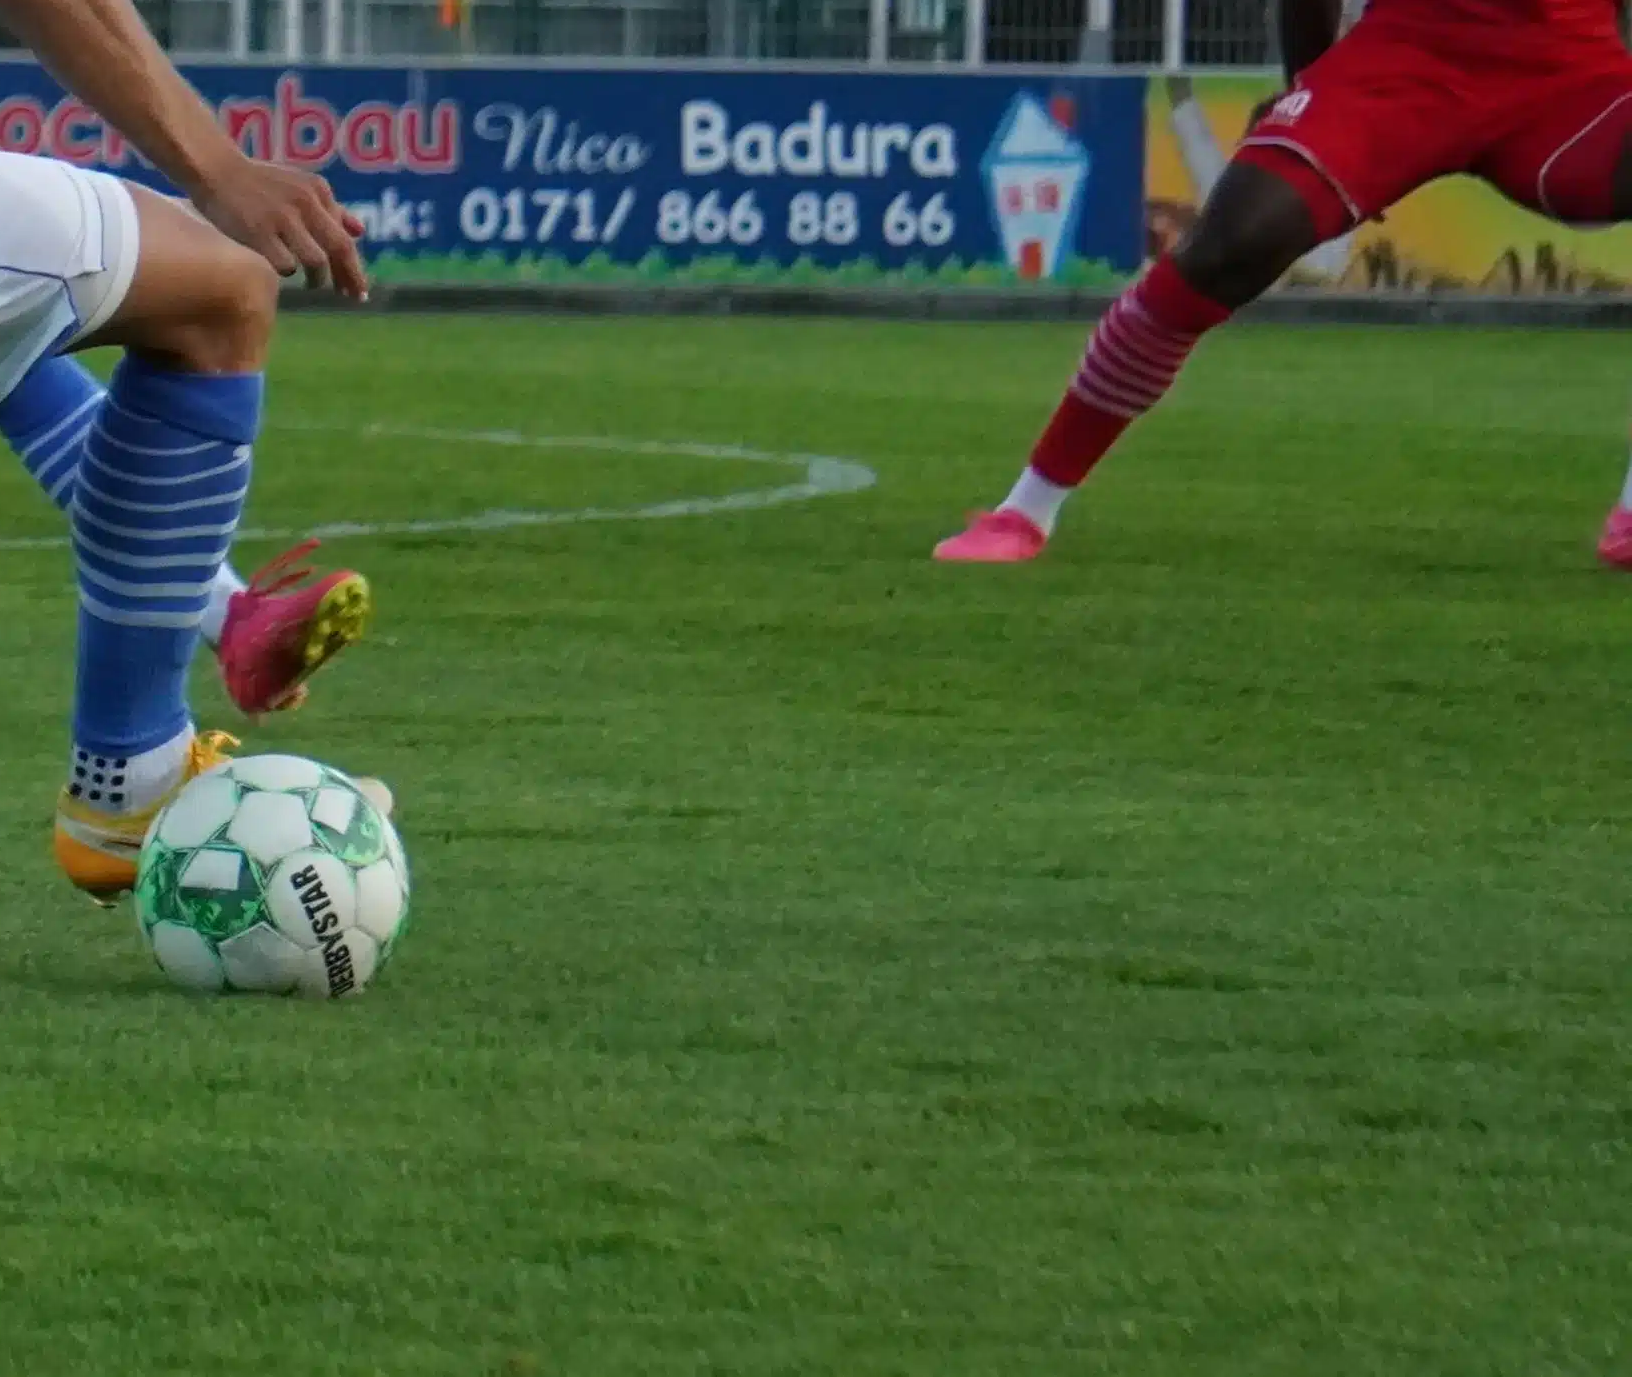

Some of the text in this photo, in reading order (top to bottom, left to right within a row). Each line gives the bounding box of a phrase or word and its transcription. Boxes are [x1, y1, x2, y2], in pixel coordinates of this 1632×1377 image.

[472, 101, 656, 176] Nico
[680, 98, 957, 179] Badura
[458, 186, 636, 244] 0171/
[656, 188, 765, 246] 866
[787, 190, 861, 246] 88
[883, 190, 955, 247] 66
